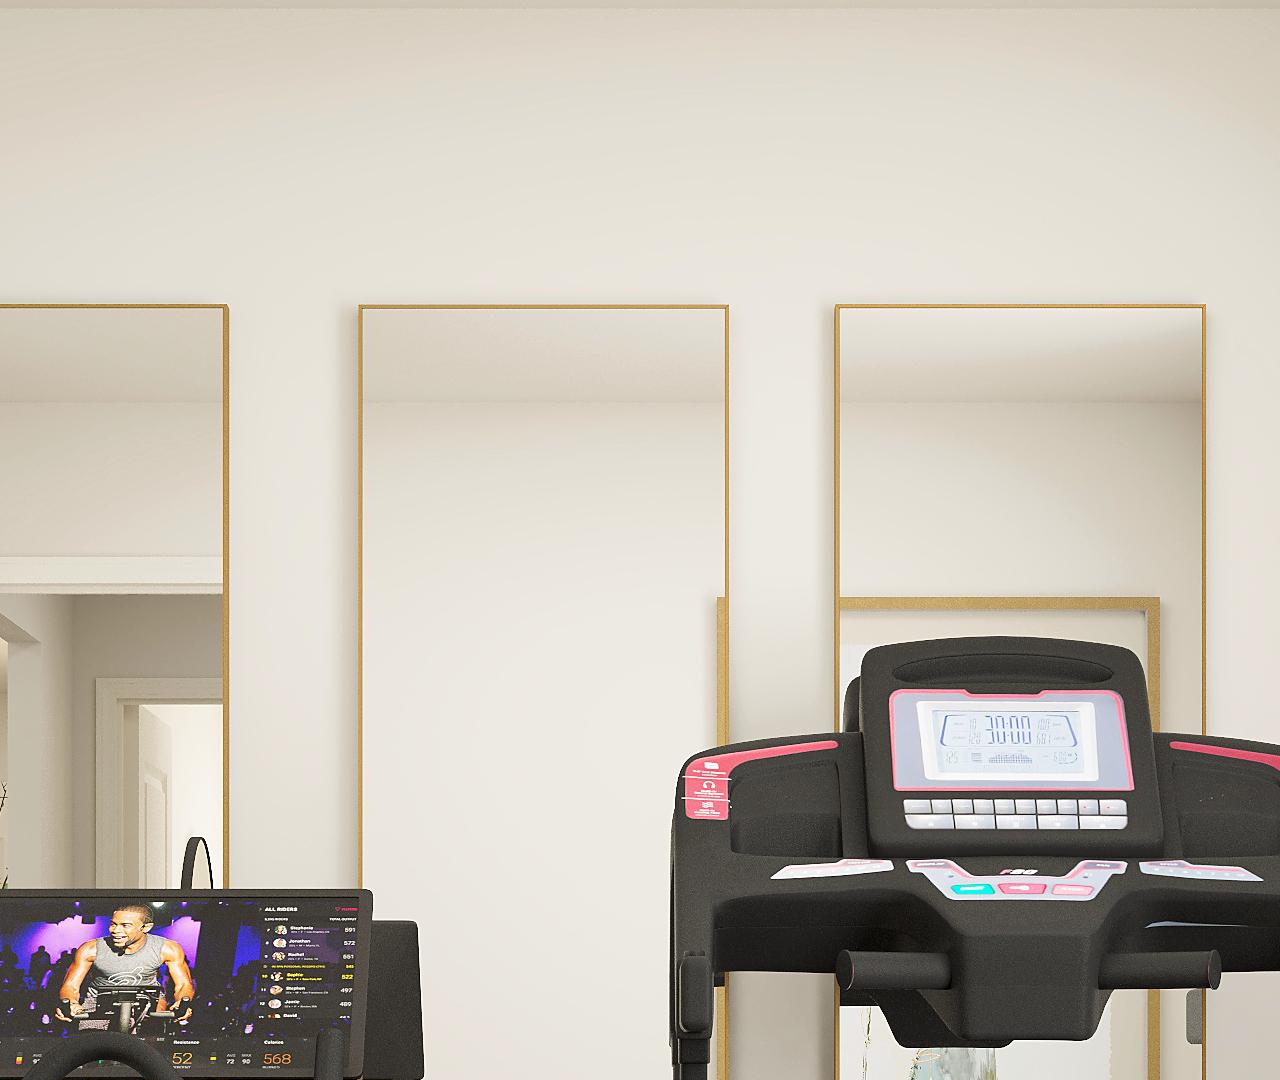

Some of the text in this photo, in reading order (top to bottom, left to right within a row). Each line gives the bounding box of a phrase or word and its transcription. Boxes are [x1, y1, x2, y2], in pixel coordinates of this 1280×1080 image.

[985, 715, 1031, 745] 30:00
[172, 1052, 193, 1065] 52
[263, 1053, 292, 1065] 568
